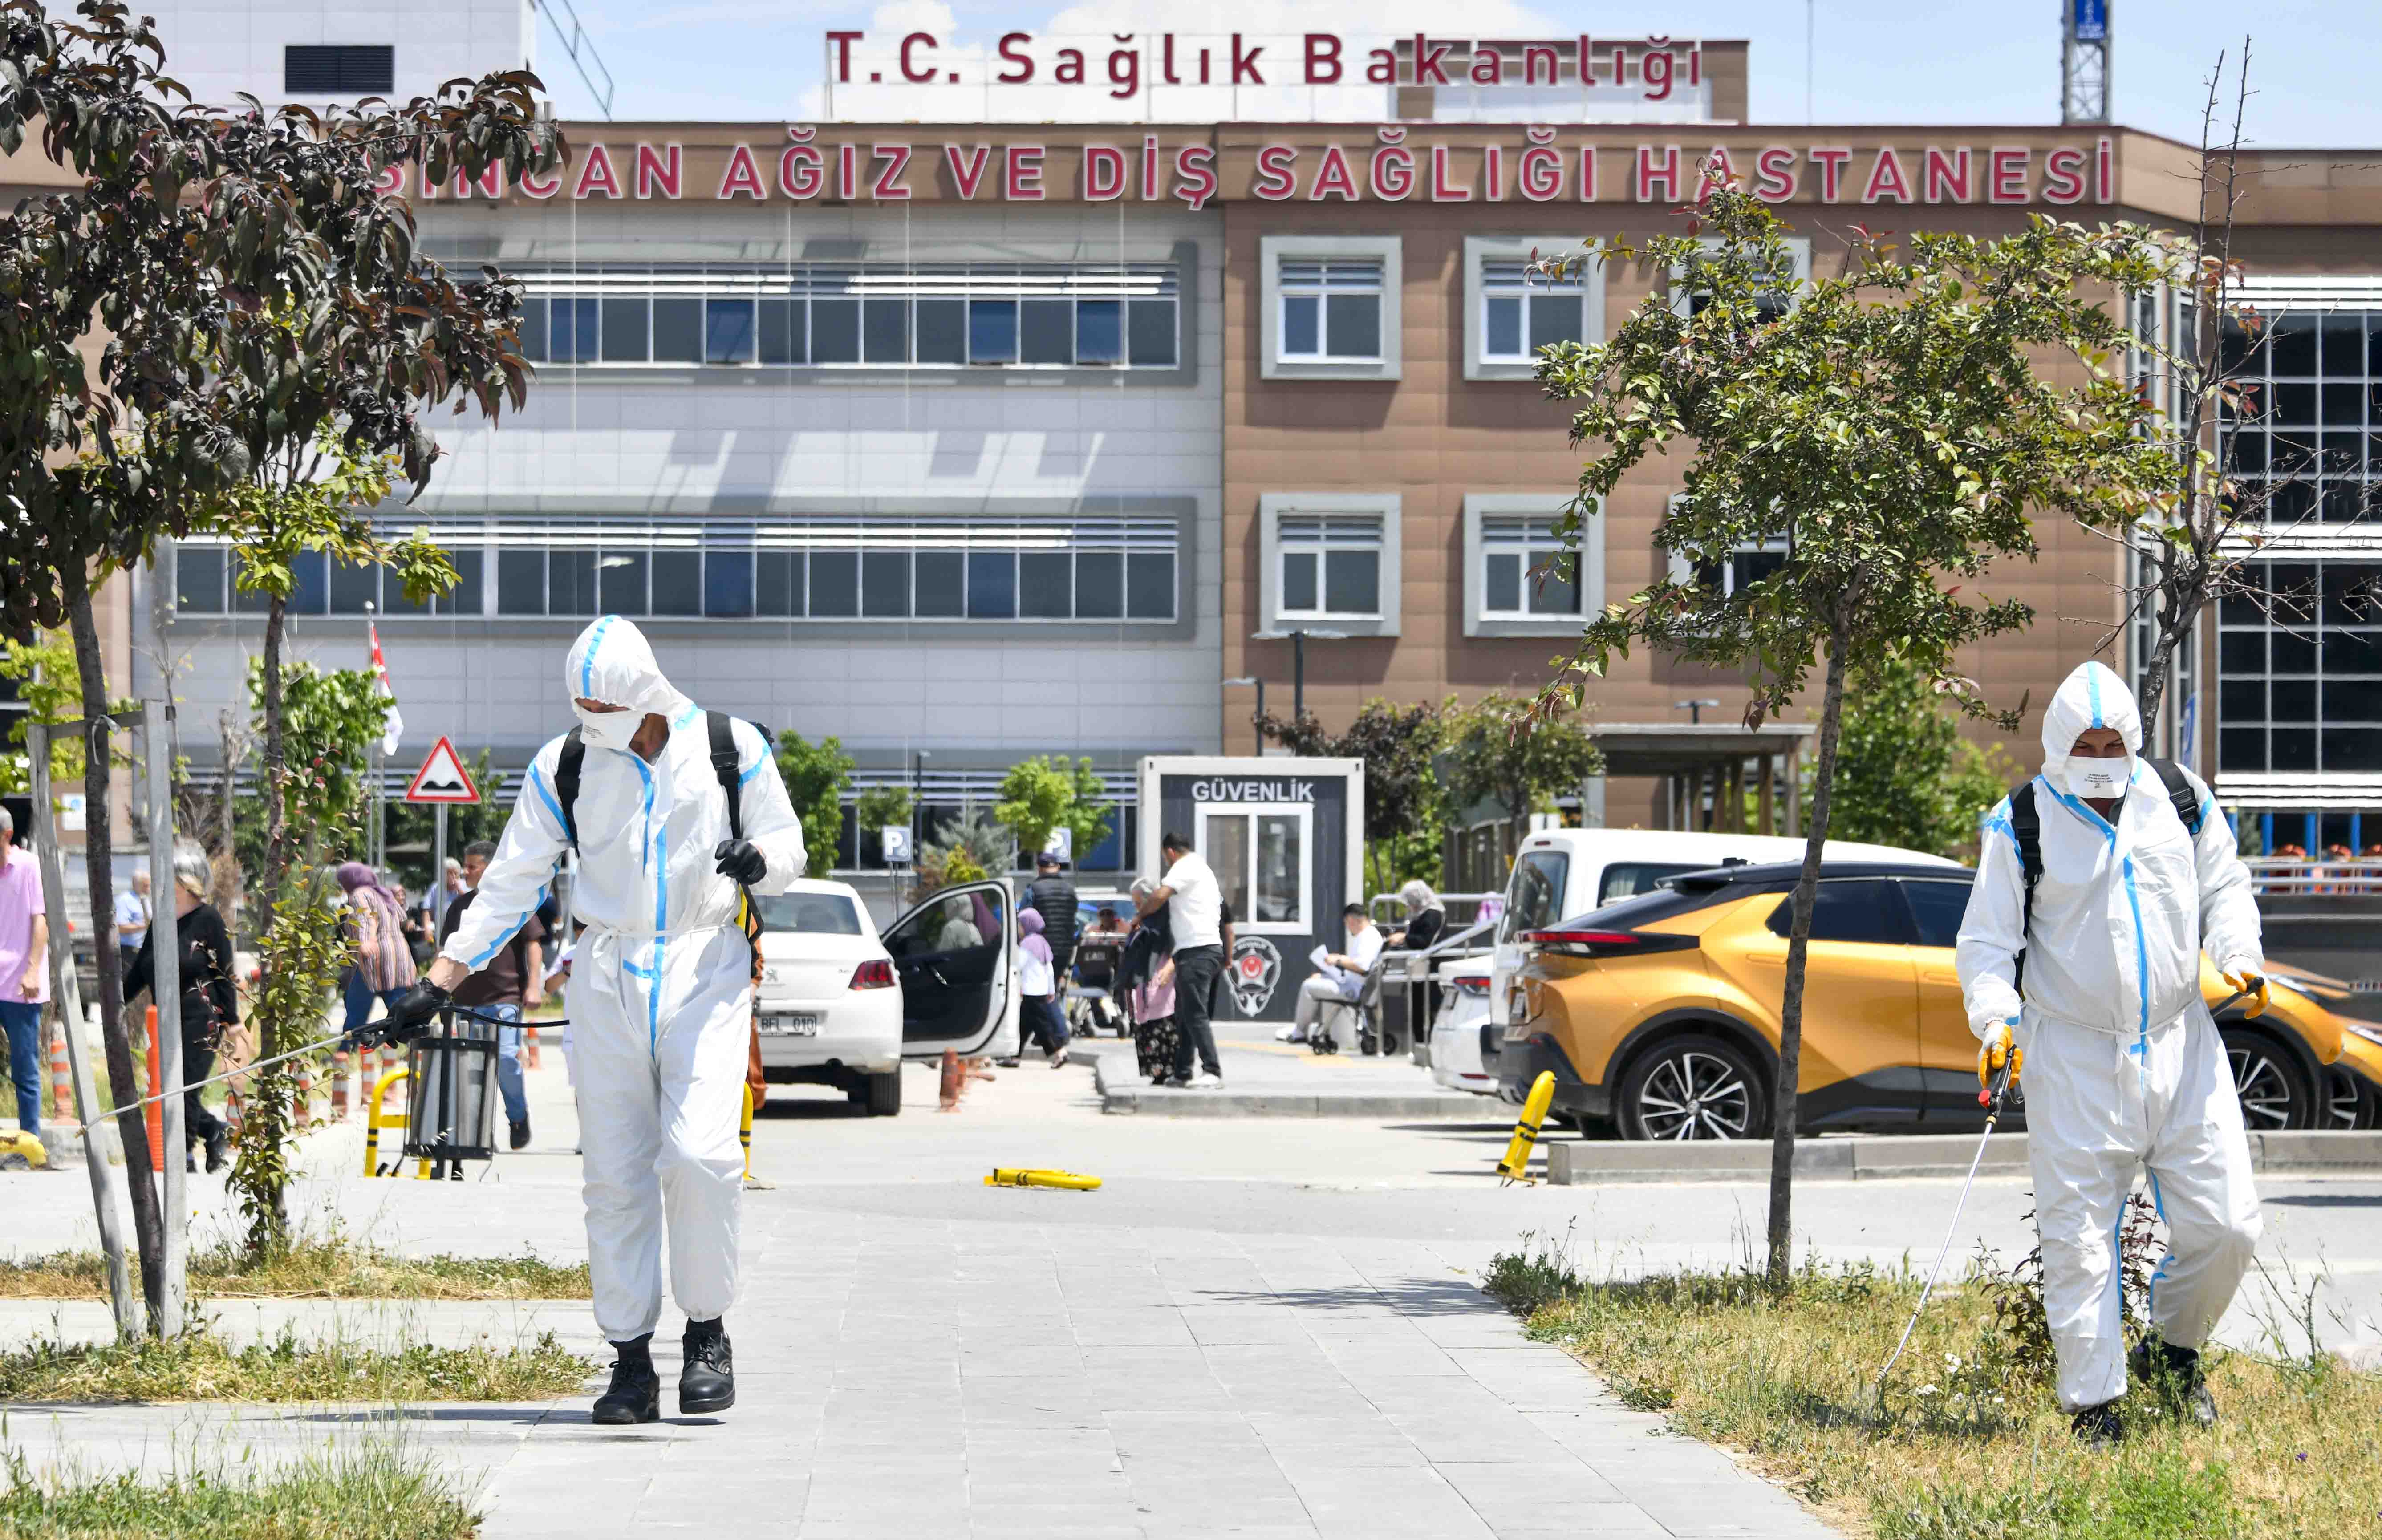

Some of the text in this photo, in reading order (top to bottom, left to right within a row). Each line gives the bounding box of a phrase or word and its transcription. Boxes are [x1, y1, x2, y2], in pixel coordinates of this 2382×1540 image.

[826, 32, 1701, 101] T.C. Sağlık Bakanlığı
[719, 126, 910, 198] AĞIZ
[945, 145, 1045, 199] VE
[1084, 136, 1217, 210] DİŞ
[1255, 126, 1595, 200] SAĞLIĞI
[1637, 136, 2112, 203] HASTANESİ
[1191, 777, 1315, 802] GÜVENLİK
[886, 831, 903, 856] P
